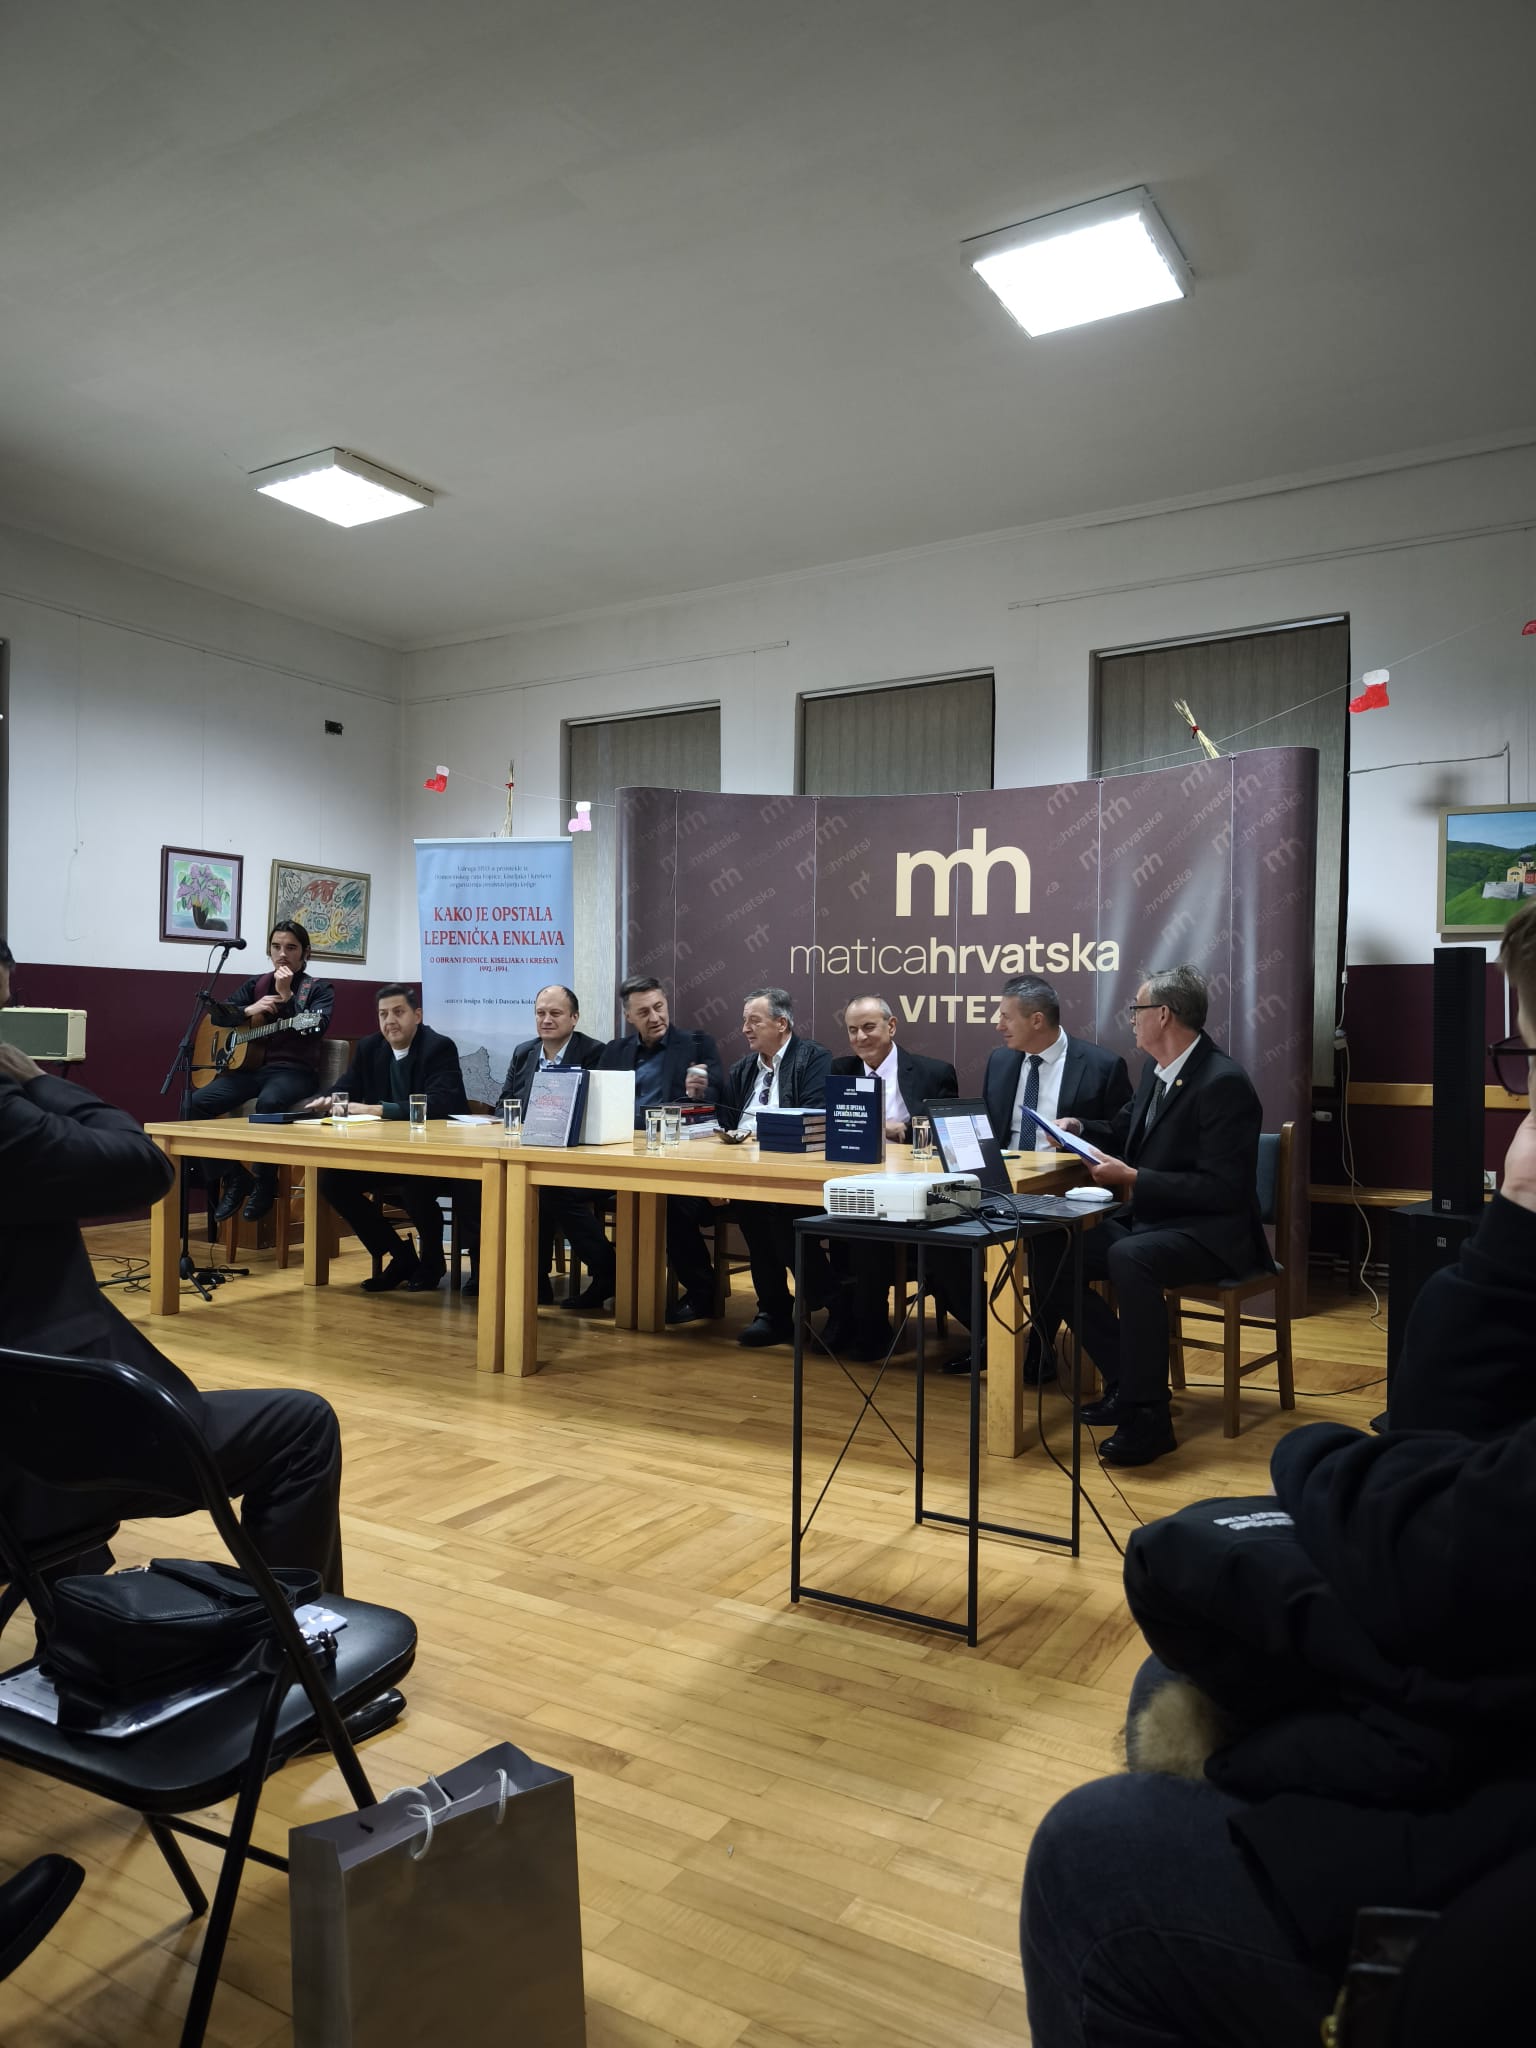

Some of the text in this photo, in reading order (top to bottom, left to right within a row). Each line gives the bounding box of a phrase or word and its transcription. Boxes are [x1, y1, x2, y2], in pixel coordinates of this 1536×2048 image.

[434, 906, 553, 922] KAKO JE OPSTALA
[424, 926, 565, 945] LEPENIČKA ENKLAVA
[529, 956, 559, 964] KREŠEVA
